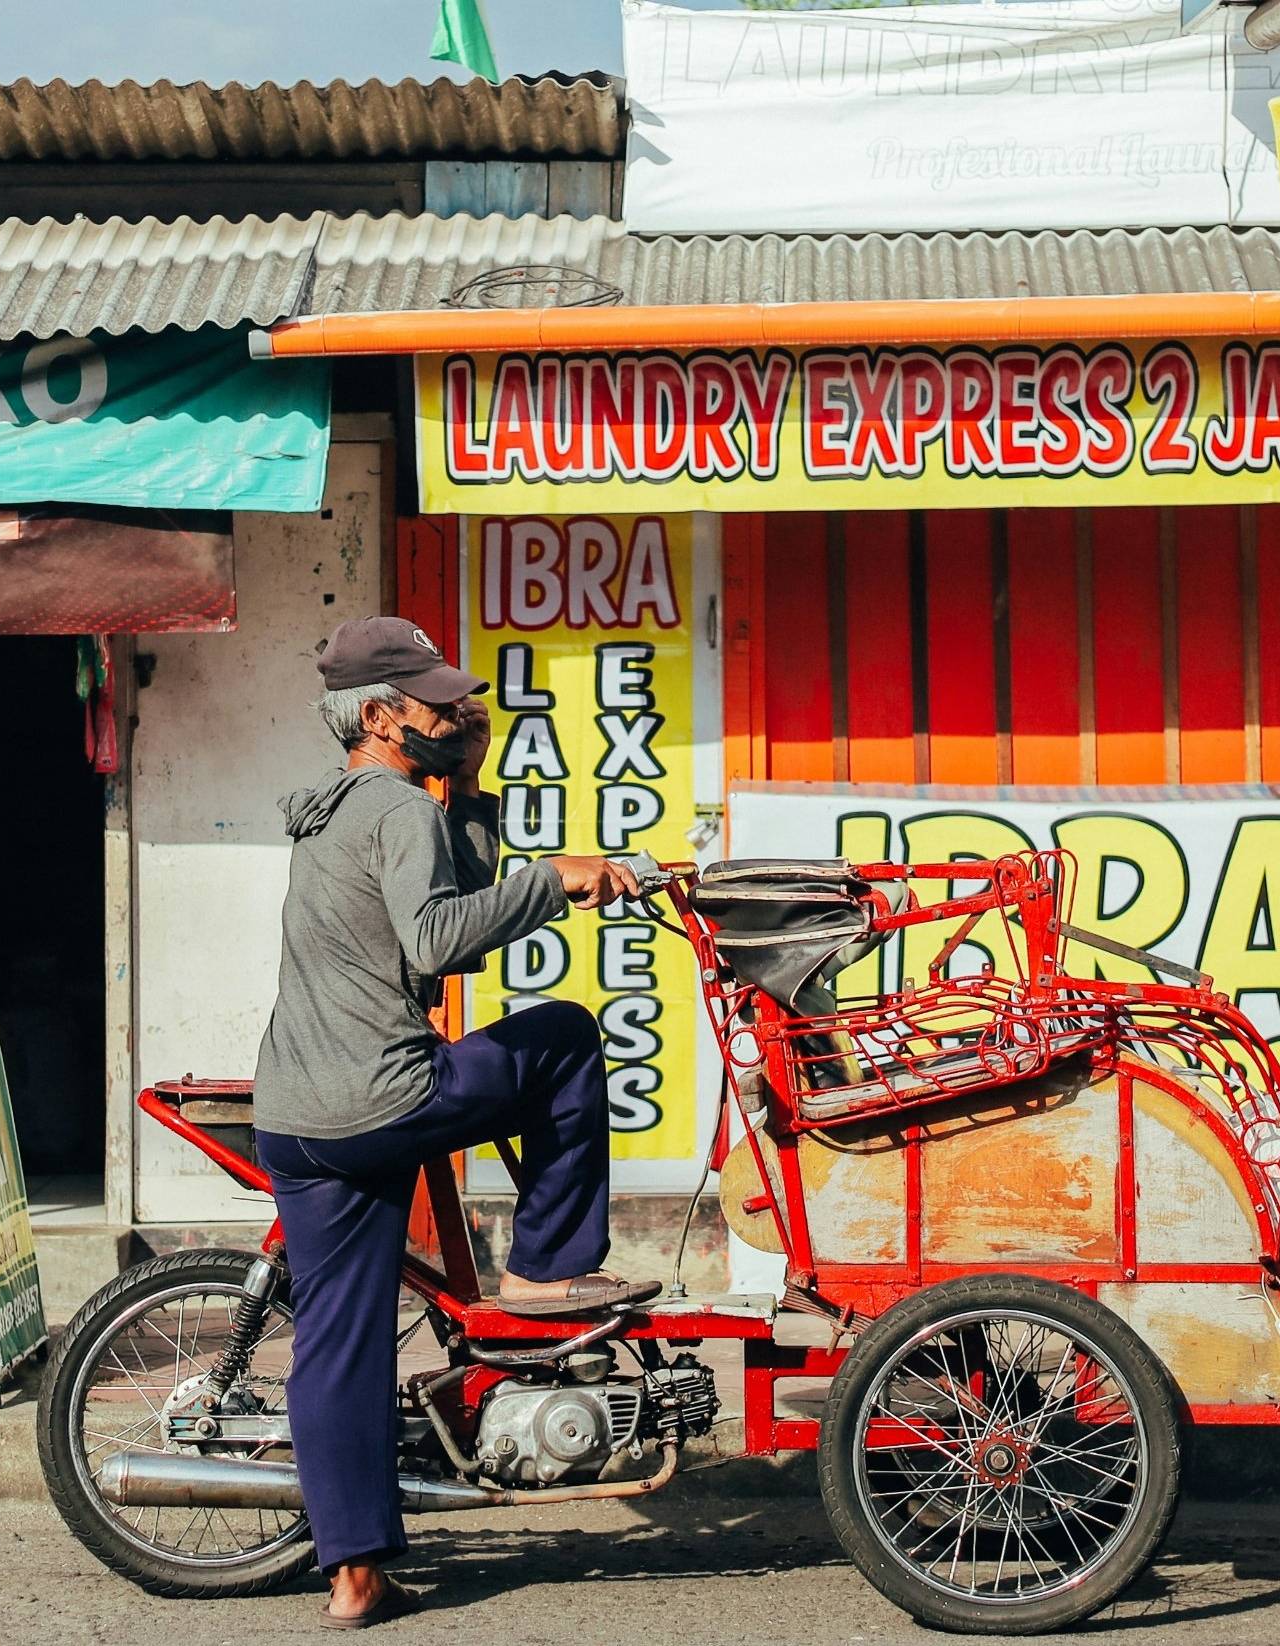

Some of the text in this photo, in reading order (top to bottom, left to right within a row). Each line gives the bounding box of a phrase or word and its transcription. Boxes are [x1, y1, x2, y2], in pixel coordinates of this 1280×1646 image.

[661, 15, 1163, 101] LAUNDRY
[867, 134, 1112, 192] Profesional
[439, 348, 790, 482] LAUNDRY
[798, 345, 1139, 476] EXPRESS
[1141, 345, 1200, 475] 2
[480, 516, 682, 632] IBRA
